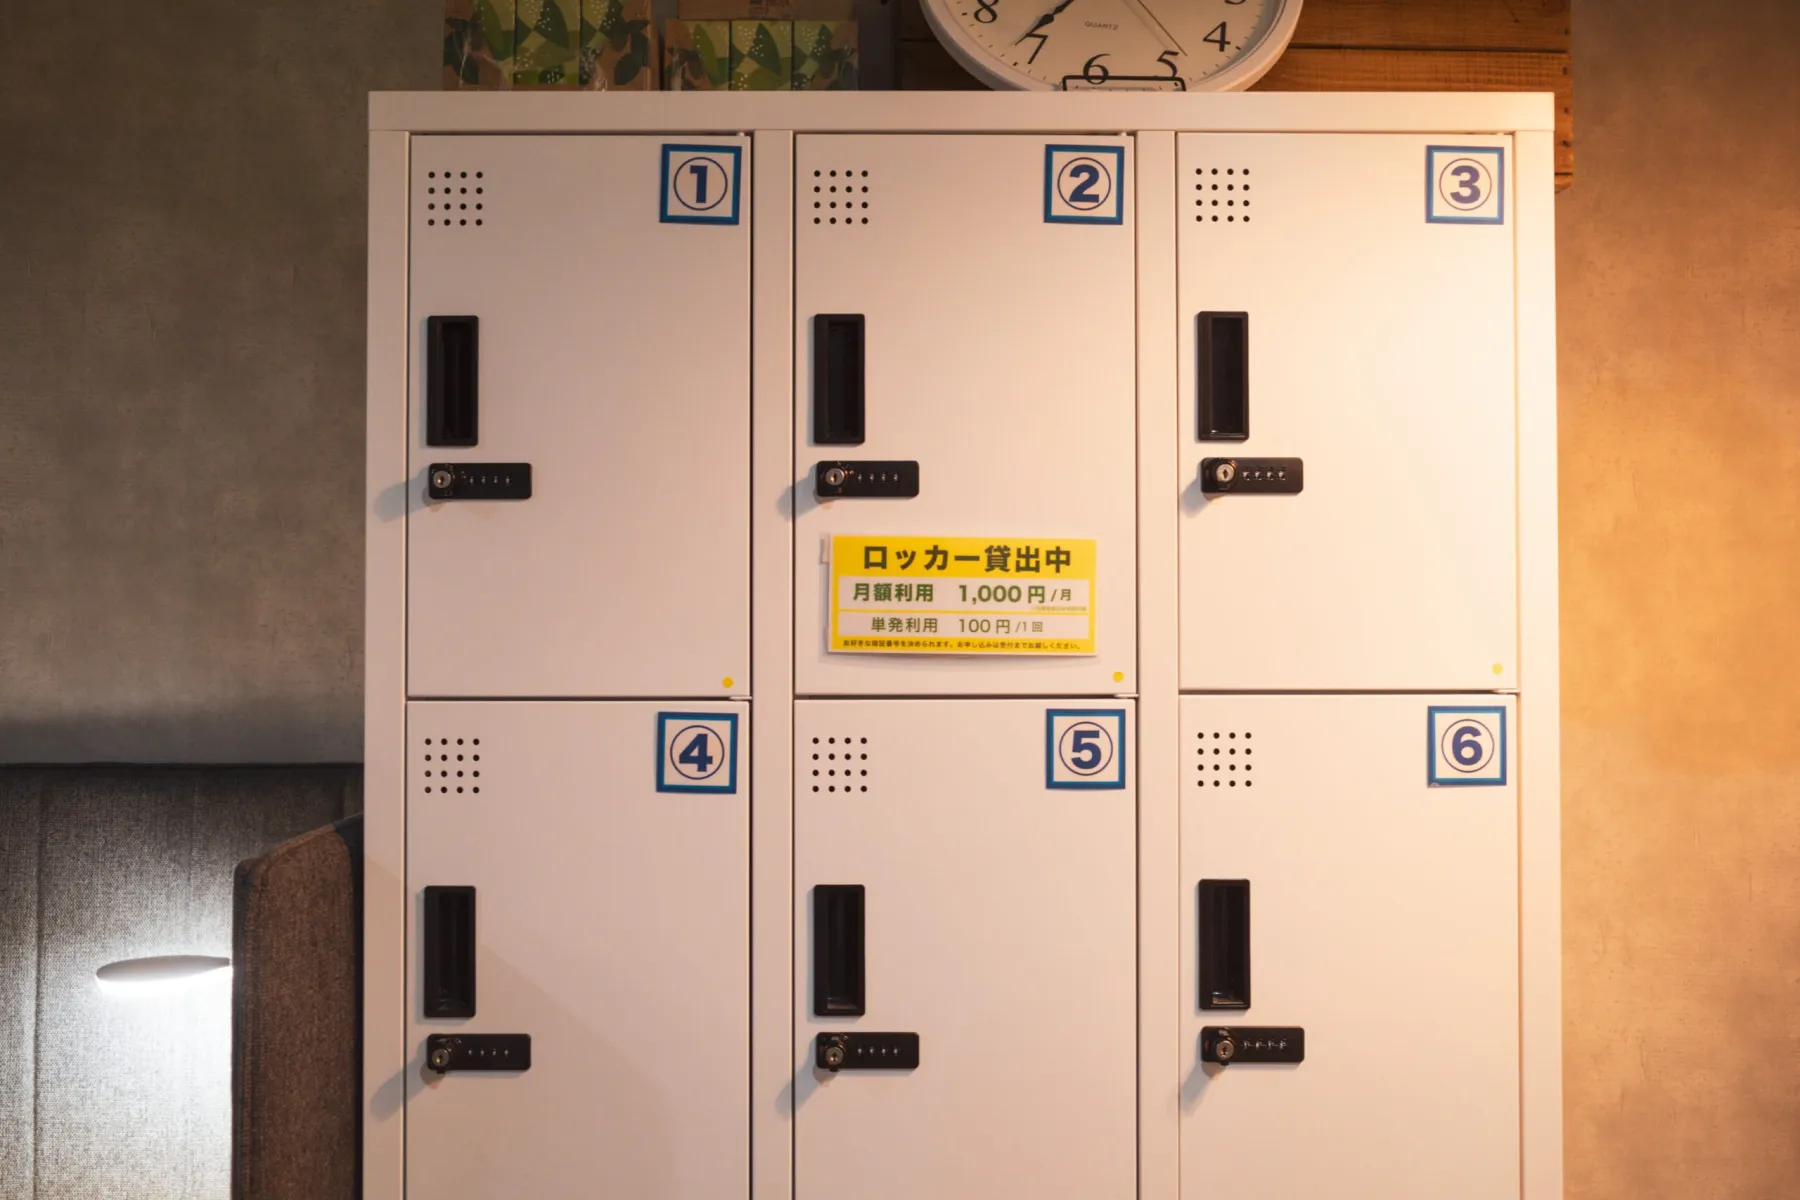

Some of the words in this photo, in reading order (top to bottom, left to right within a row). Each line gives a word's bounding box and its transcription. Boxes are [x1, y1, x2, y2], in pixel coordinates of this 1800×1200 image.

[1084, 20, 1119, 31] QUARTZ
[1202, 21, 1231, 52] 4
[1026, 33, 1049, 65] 7
[1083, 53, 1110, 85] 6
[1156, 50, 1179, 78] 5
[864, 544, 1071, 574] ロッカー貸出中
[852, 582, 934, 603] 月額利用
[871, 617, 938, 634] 単発利用
